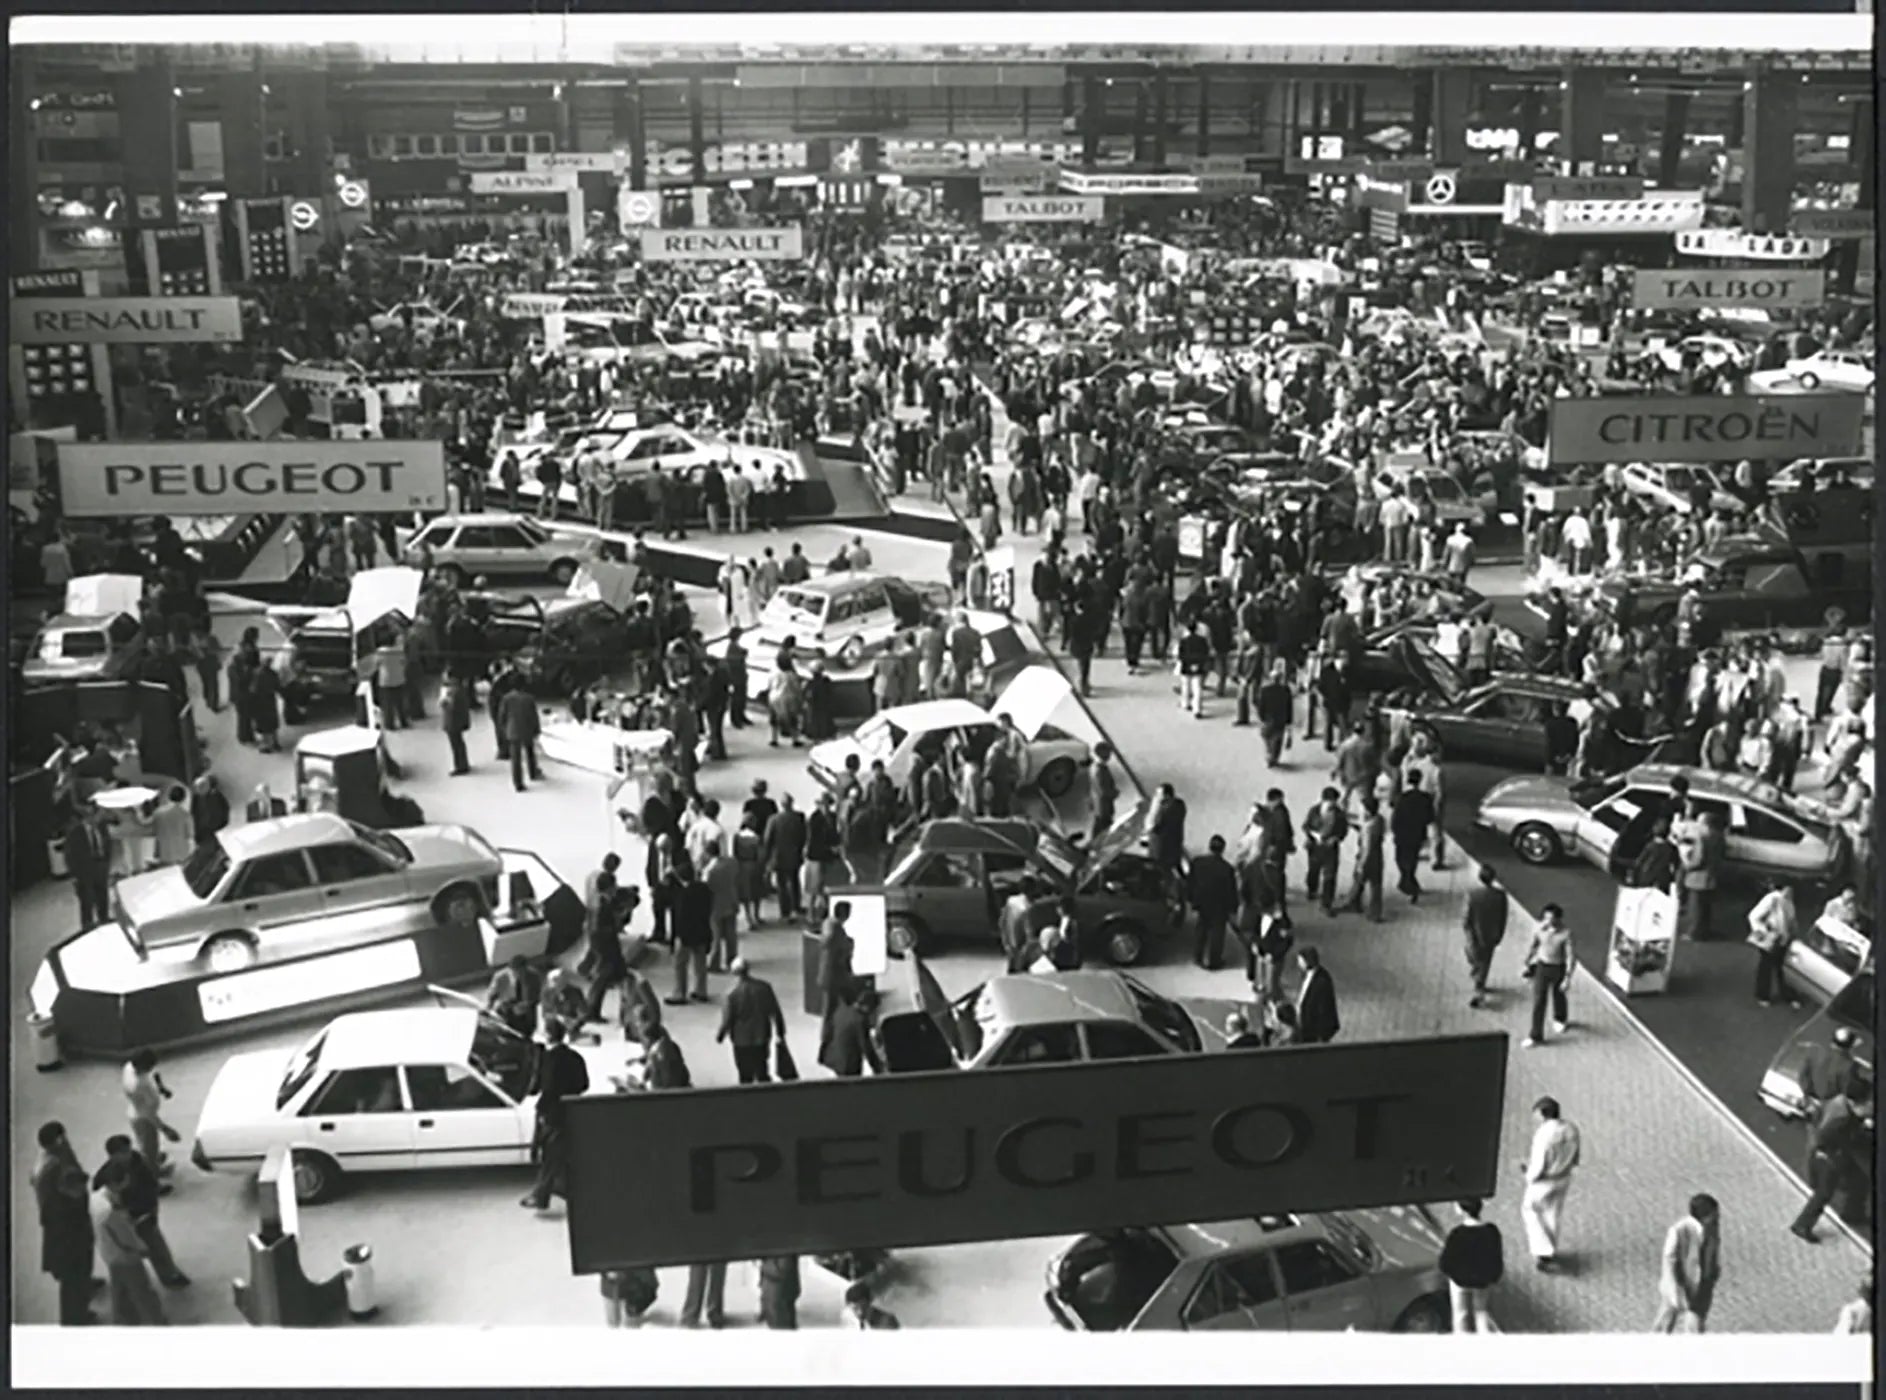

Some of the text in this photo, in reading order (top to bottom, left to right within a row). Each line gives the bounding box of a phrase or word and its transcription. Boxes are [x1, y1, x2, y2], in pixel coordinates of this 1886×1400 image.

[1003, 202, 1085, 215] TALBOT
[664, 235, 783, 251] RENAULT
[16, 272, 79, 289] RENAULT
[1662, 279, 1795, 299] TALBOT
[32, 308, 207, 332] RENAULT
[1599, 405, 1819, 444] CITROËN
[103, 461, 405, 496] PEUGEOT
[688, 1093, 1412, 1213] PEUGEOT
